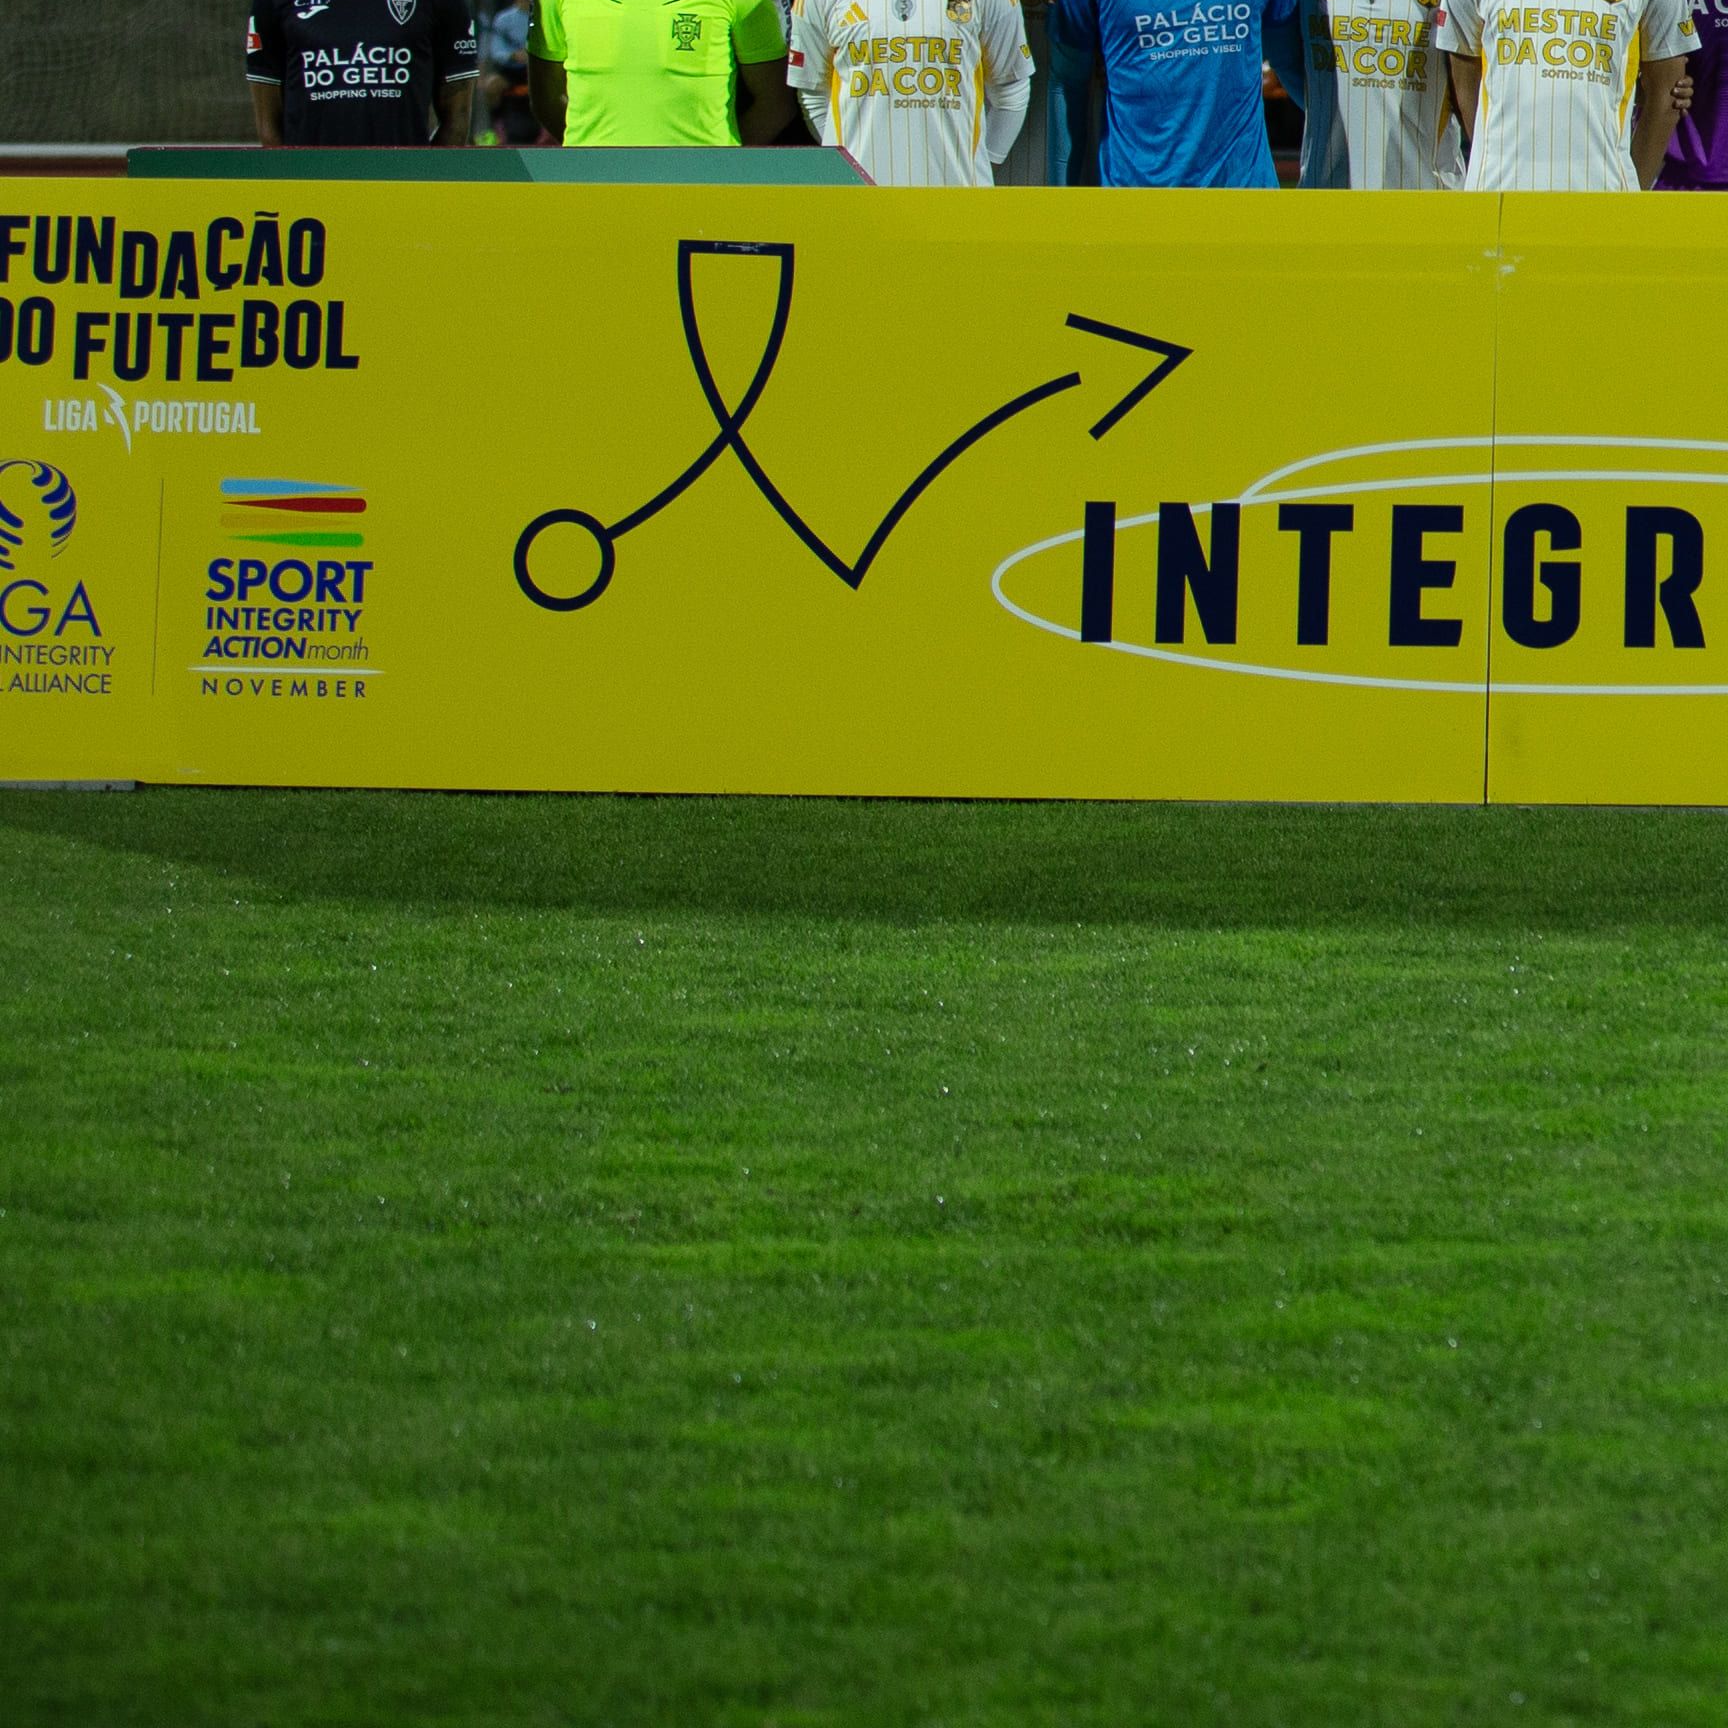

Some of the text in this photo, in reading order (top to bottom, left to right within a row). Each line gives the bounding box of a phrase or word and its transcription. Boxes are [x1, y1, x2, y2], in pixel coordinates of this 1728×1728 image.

[1135, 2, 1251, 33] PALÁCIO
[1309, 14, 1431, 47] MESTRE
[1497, 8, 1618, 41] MESTRE
[847, 37, 963, 65] MESTRE
[1139, 23, 1249, 49] DO GELO
[302, 42, 412, 68] PALÁCIO
[1150, 47, 1209, 61] SHOPPING
[1313, 43, 1428, 79] DA COR
[1497, 37, 1614, 73] DA COR
[304, 67, 410, 88] DO GELO
[850, 67, 961, 97] DA COR
[310, 89, 367, 101] SHOPPING
[0, 211, 327, 300] FUNDAÇÃO
[73, 299, 360, 383] FUTEBOL
[43, 398, 262, 435] LIGA PORTUGAL
[205, 557, 374, 604] SPORT
[0, 578, 102, 638] GA
[206, 607, 363, 633] INTEGRITY
[8, 672, 112, 694] ALLIANCE
[202, 677, 366, 698] NOVEMBER
